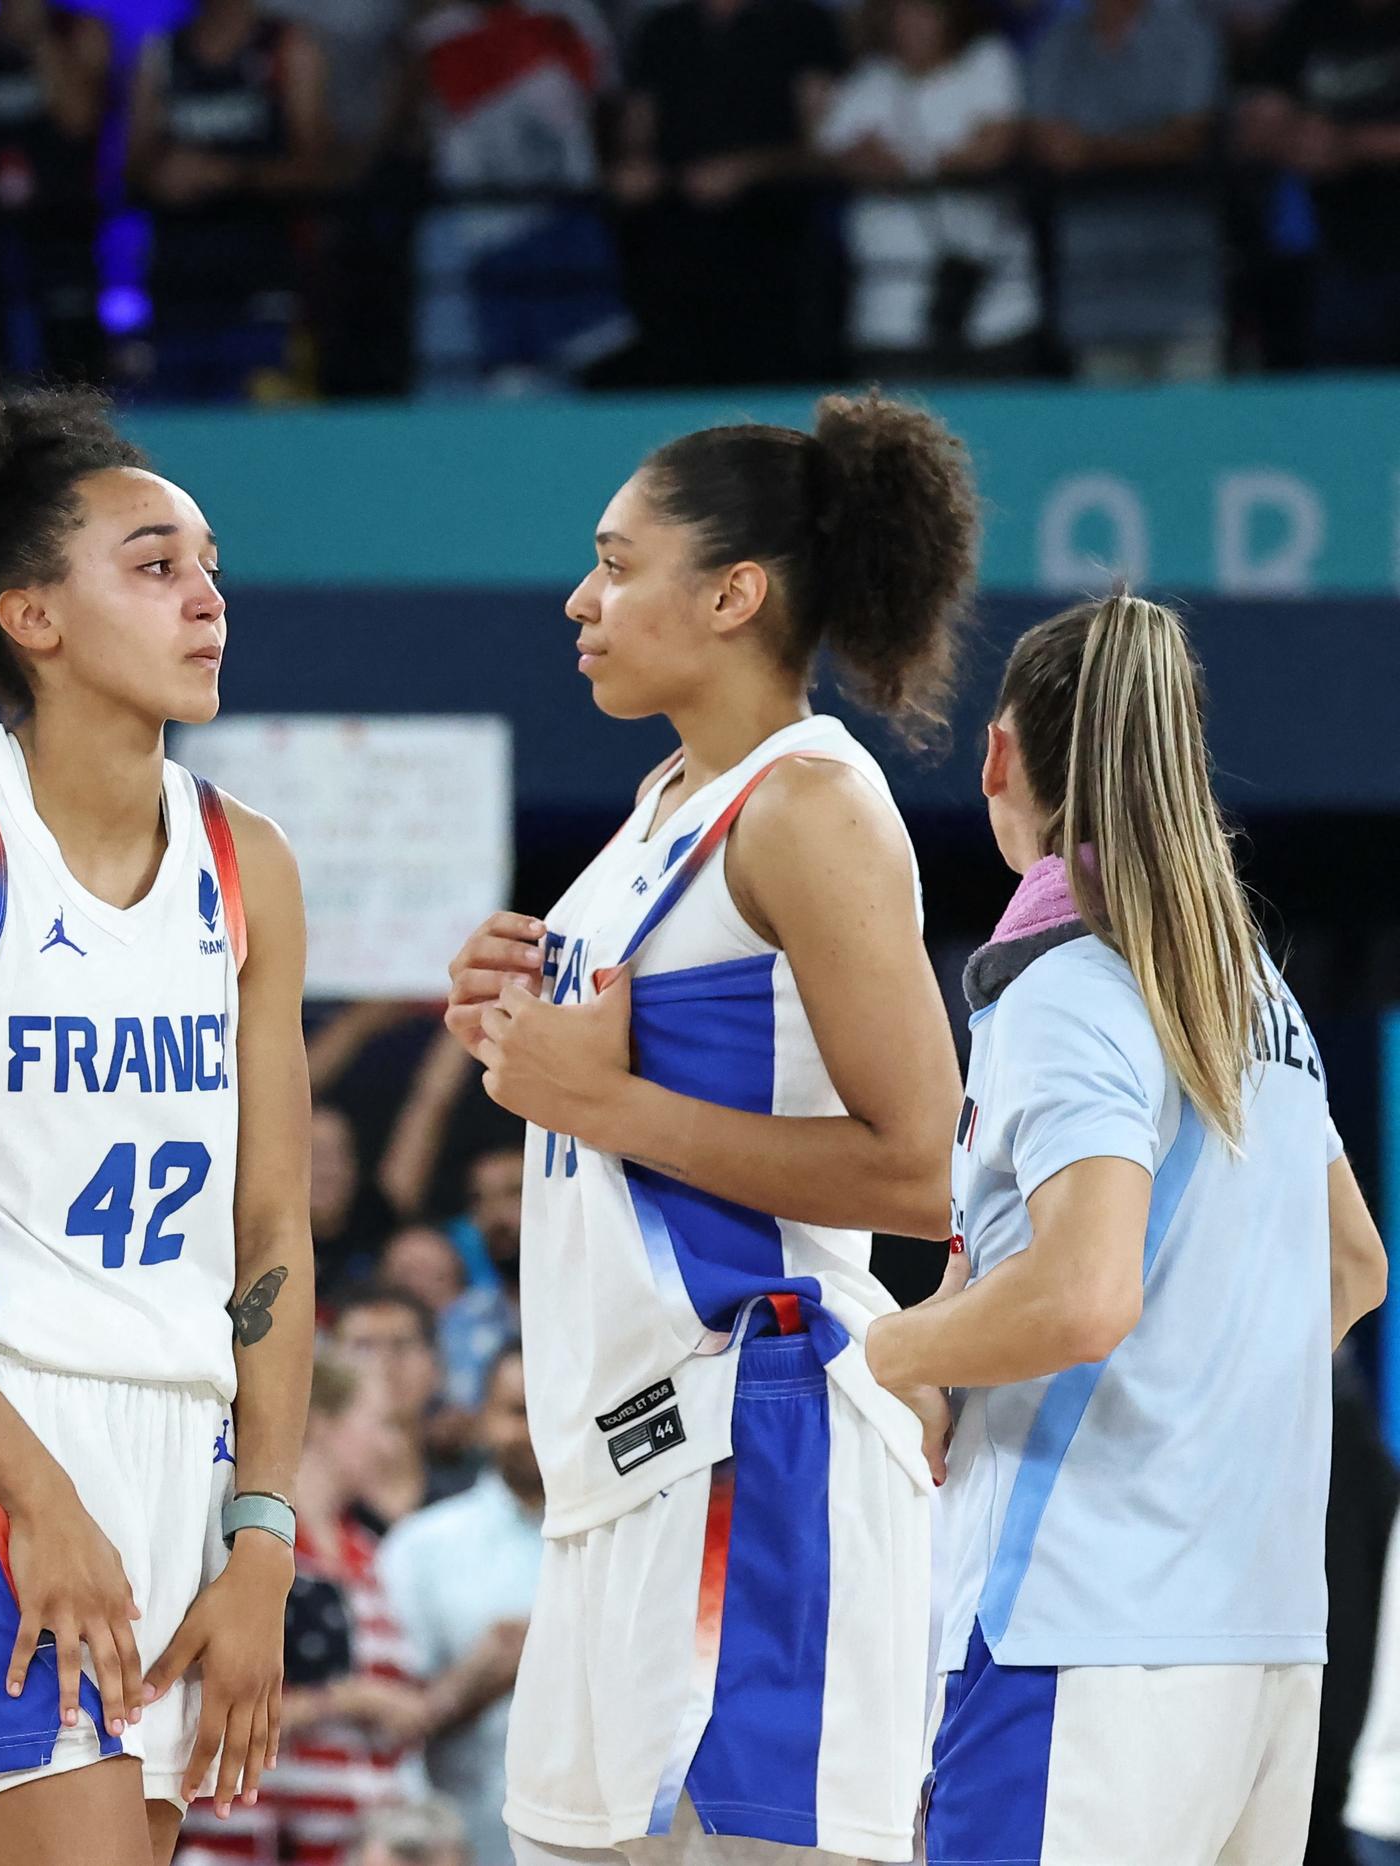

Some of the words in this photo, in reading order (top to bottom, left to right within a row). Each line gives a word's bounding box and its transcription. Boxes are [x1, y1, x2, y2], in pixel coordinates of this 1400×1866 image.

[199, 936, 225, 955] FRAN
[7, 1013, 229, 1093] FRANC
[65, 1140, 212, 1268] 42
[603, 1405, 637, 1426] TOUTES
[635, 1398, 647, 1410] ET
[647, 1384, 670, 1402] TOUS
[655, 1420, 674, 1439] 44
